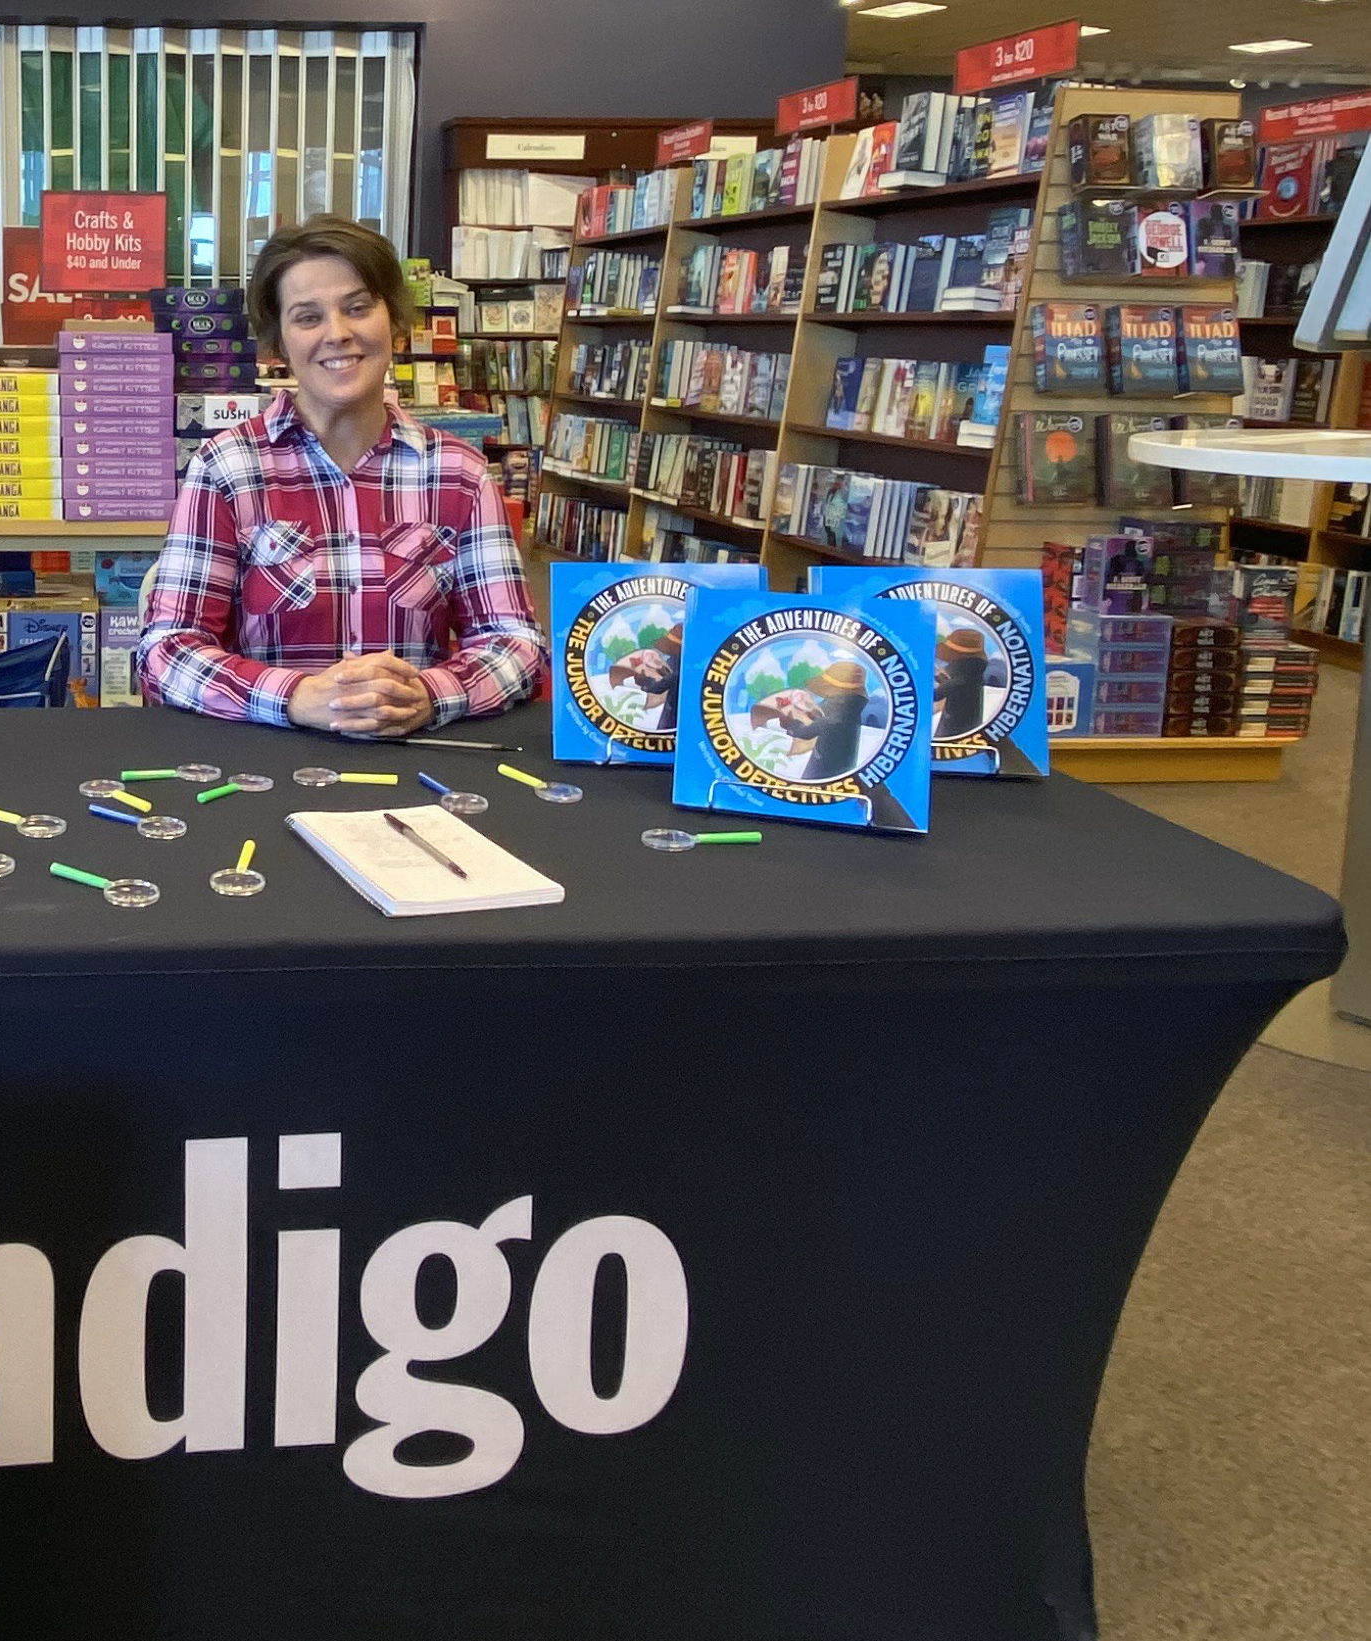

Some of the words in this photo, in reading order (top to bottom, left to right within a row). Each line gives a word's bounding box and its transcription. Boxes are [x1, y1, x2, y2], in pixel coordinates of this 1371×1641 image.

[995, 46, 1004, 67] 3
[1014, 38, 1034, 62] $20
[801, 97, 808, 114] 3
[74, 210, 118, 229] Crafts
[123, 211, 134, 230] &
[66, 233, 110, 255] Hobby
[115, 233, 142, 252] Kits
[66, 255, 87, 270] $40
[89, 257, 109, 269] and
[111, 256, 142, 270] Under
[213, 409, 251, 420] SUSHI
[590, 590, 617, 615] THE
[974, 599, 997, 617] OF
[568, 617, 596, 651] THE
[734, 620, 768, 647] THE
[766, 609, 862, 640] ADVENTURES
[857, 629, 883, 650] OF
[708, 649, 739, 686] THE
[984, 620, 1033, 742] HIBERNATION
[566, 652, 604, 722] JUNIOR
[703, 686, 742, 765] JUNIOR
[858, 654, 918, 788] HIBERNATION
